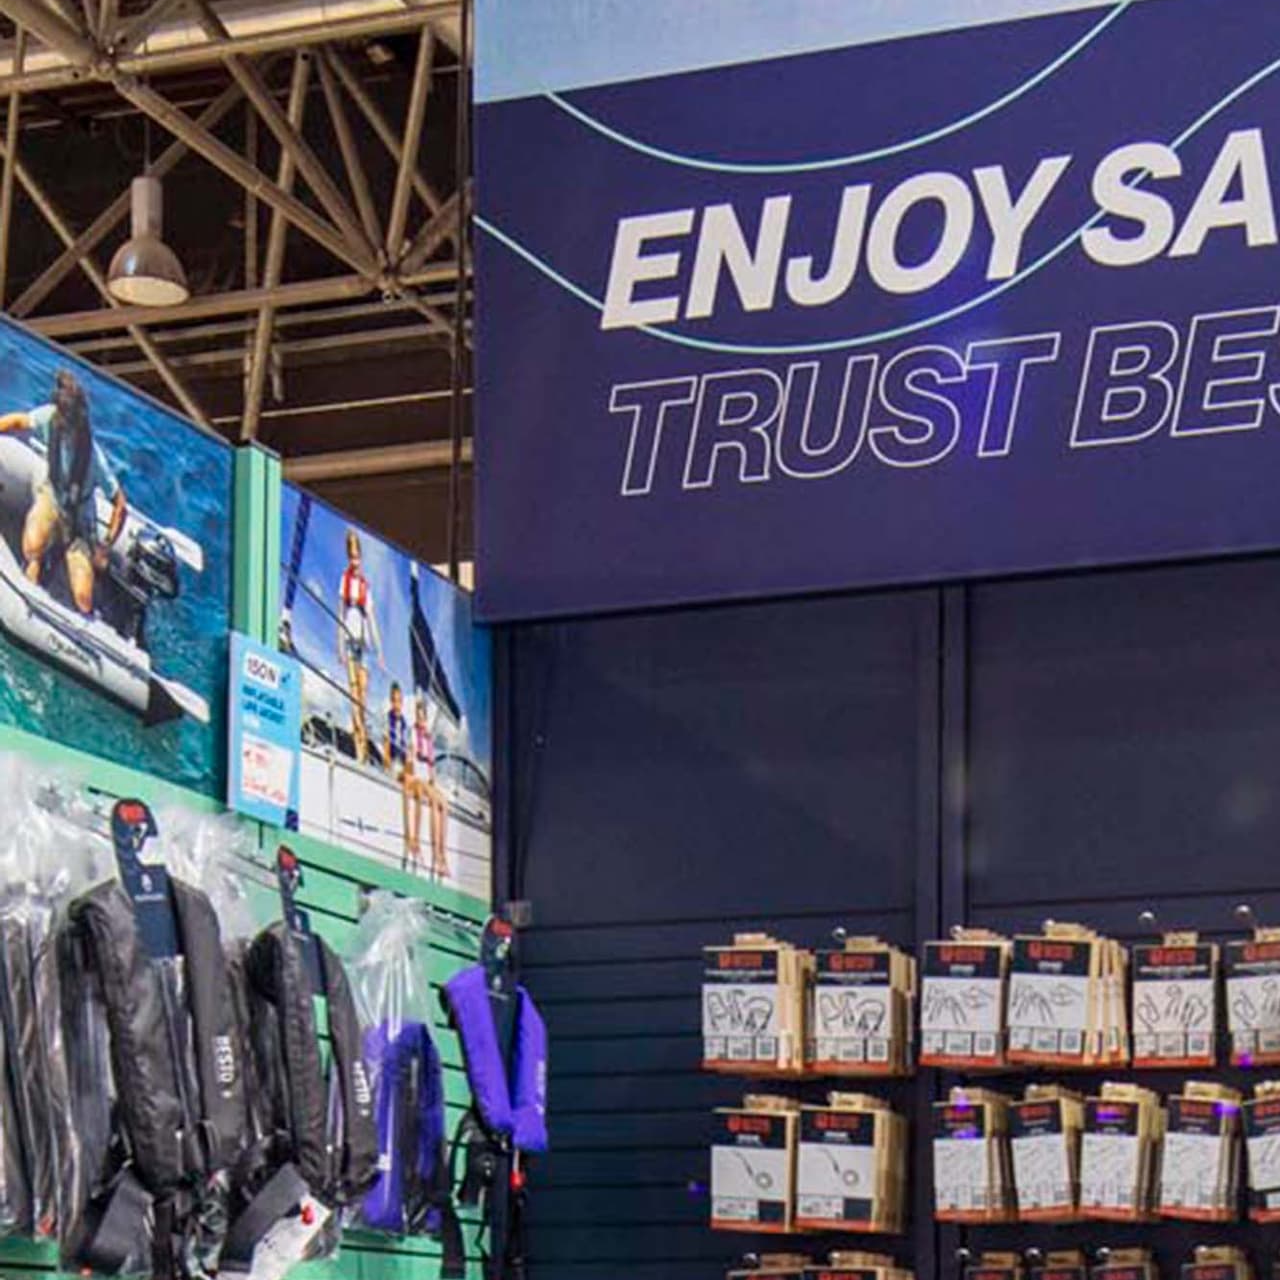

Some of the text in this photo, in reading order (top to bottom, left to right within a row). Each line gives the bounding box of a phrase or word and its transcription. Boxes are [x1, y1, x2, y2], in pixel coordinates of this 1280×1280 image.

[599, 155, 1071, 330] ENJOY
[608, 331, 1061, 496] TRUST
[216, 1036, 235, 1083] BESTO
